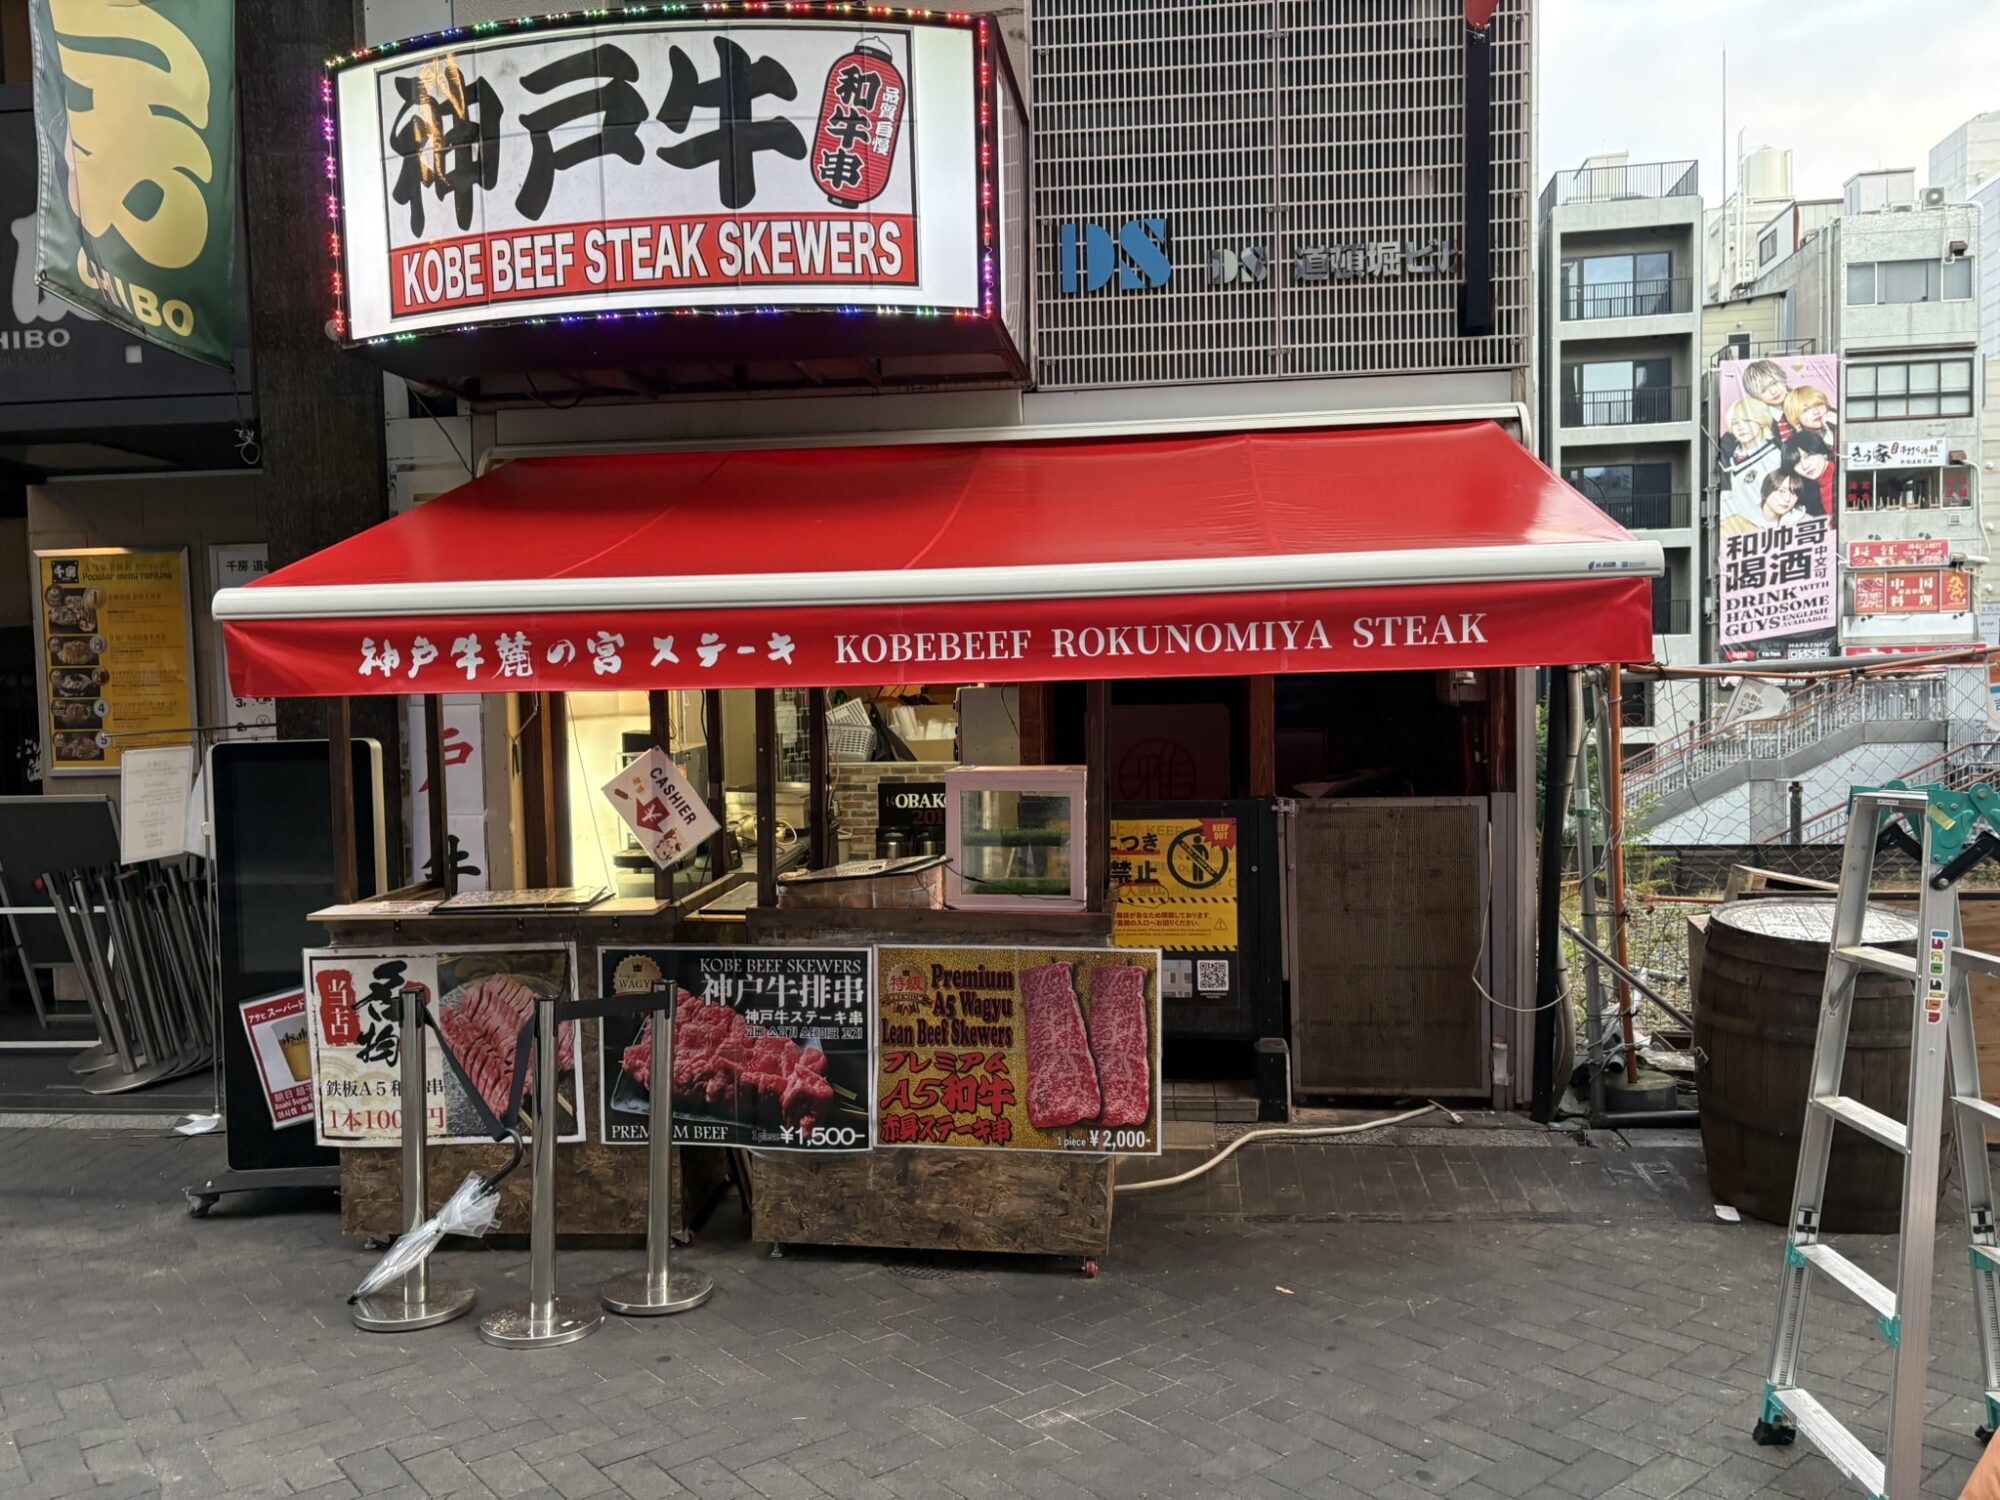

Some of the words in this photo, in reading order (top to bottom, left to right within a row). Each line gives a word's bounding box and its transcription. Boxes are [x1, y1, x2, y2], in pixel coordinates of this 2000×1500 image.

[391, 36, 807, 238] 神戸牛
[818, 64, 882, 190] 和牛串
[400, 243, 484, 306] KOBE
[490, 230, 575, 293] BEEF
[583, 221, 708, 284] STEAK
[717, 218, 903, 277] SKEWERS
[1061, 219, 1171, 293] DS
[1727, 518, 1828, 561] 和帅哥
[82, 572, 114, 582] Popular
[140, 571, 173, 581] ranking
[226, 560, 248, 573] 千房
[1725, 547, 1812, 593] 喝酒
[1725, 586, 1798, 611] DRINK
[1799, 581, 1829, 593] WITH
[1726, 595, 1830, 623] HANDSOME
[1725, 616, 1781, 637] GUYS
[1782, 607, 1829, 621] ENGLISH
[1782, 615, 1829, 628] AVAILABLE
[650, 632, 797, 668] ステーキ
[834, 630, 1032, 665] KOBEBEEF
[1051, 619, 1333, 659] ROKUNOMIYA
[1353, 612, 1488, 649] STEAK
[1788, 641, 1830, 649] MAP&INFO
[97, 702, 105, 714] 4
[650, 767, 697, 825] CASHIER
[1212, 824, 1230, 832] KEEP
[1213, 832, 1229, 840] OUT
[700, 959, 742, 973] KOBE
[746, 959, 783, 973] BEEF
[787, 958, 862, 973] SKEWERS
[931, 964, 1014, 991] Premium
[745, 1009, 863, 1026] 神戸牛ステーキ串
[932, 991, 955, 1019] A5
[959, 991, 1013, 1024] Wagyu
[881, 1018, 914, 1046] Lean
[916, 1018, 949, 1046] Beef
[951, 1018, 1013, 1047] Skewers
[882, 1051, 1009, 1074] プレミアム
[880, 1074, 1016, 1115] A5和牛
[693, 1126, 728, 1140] BEEF
[880, 1113, 1013, 1145] 赤身ステーキ串
[1064, 1136, 1086, 1148] piece
